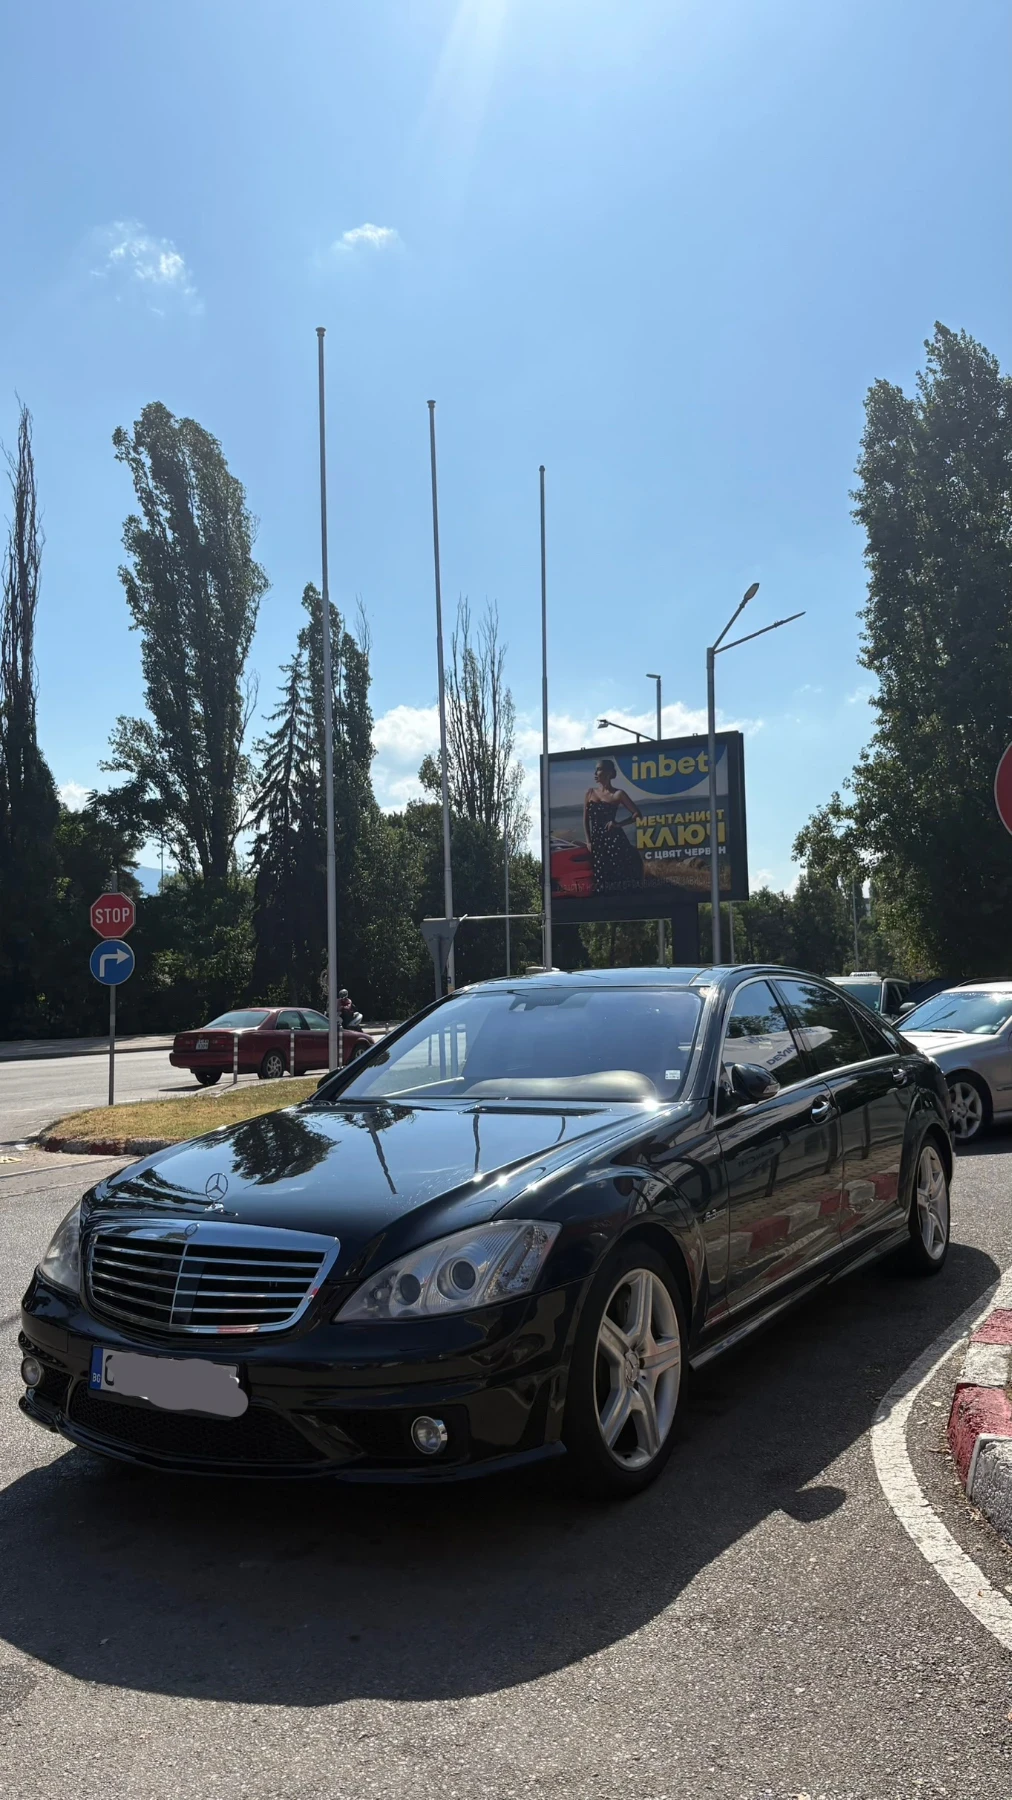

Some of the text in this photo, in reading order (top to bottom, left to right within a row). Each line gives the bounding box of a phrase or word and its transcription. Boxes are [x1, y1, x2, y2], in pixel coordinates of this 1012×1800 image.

[632, 750, 709, 780] inbet
[637, 822, 726, 849] КЛЮЧ
[645, 846, 726, 859] С ЦВЯТ ЧЕРВН
[95, 907, 130, 924] STOP
[92, 1371, 101, 1383] BG
